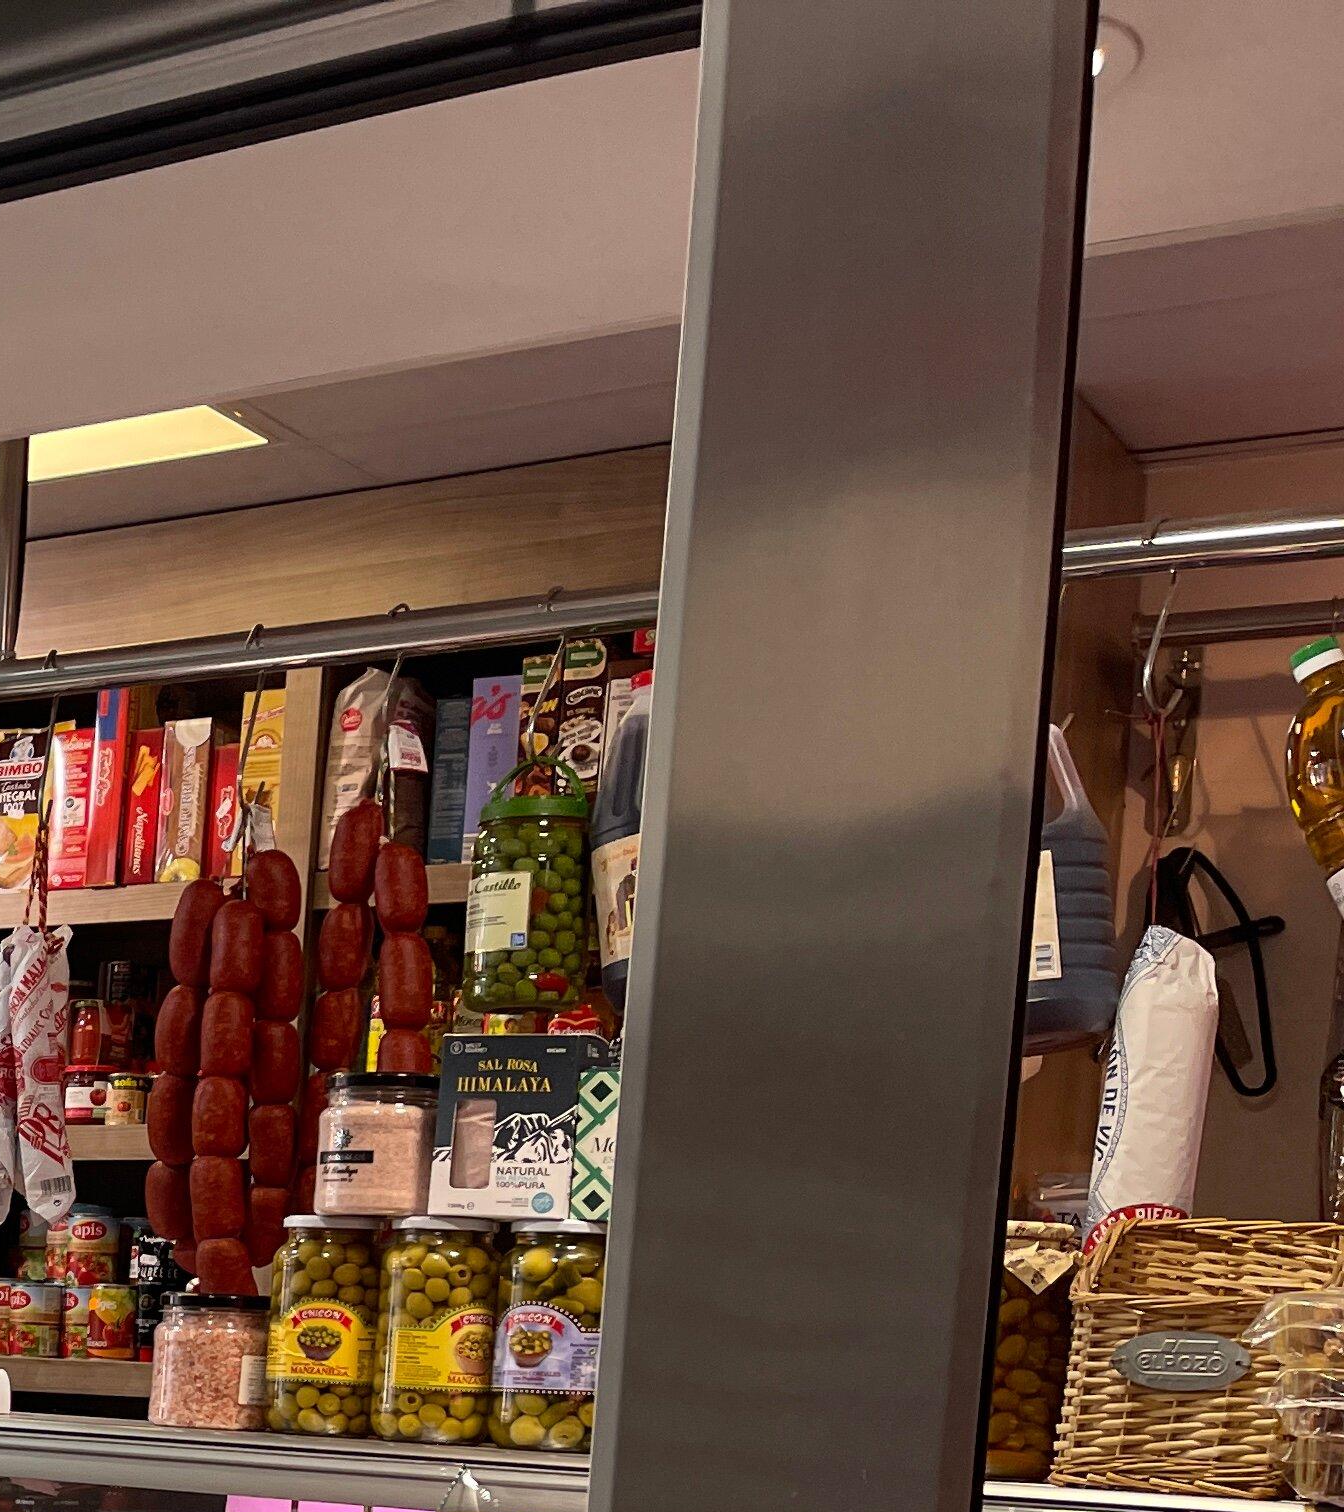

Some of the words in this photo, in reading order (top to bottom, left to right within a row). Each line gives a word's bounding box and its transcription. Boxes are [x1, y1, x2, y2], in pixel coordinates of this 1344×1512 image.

[474, 877, 522, 894] Castillo
[477, 1058, 503, 1072] SAL
[507, 1058, 539, 1073] ROSA
[456, 1076, 552, 1093] HIMALAYA
[496, 1166, 551, 1177] NATURAL
[73, 1223, 104, 1240] apis
[462, 1313, 494, 1325] CHICO
